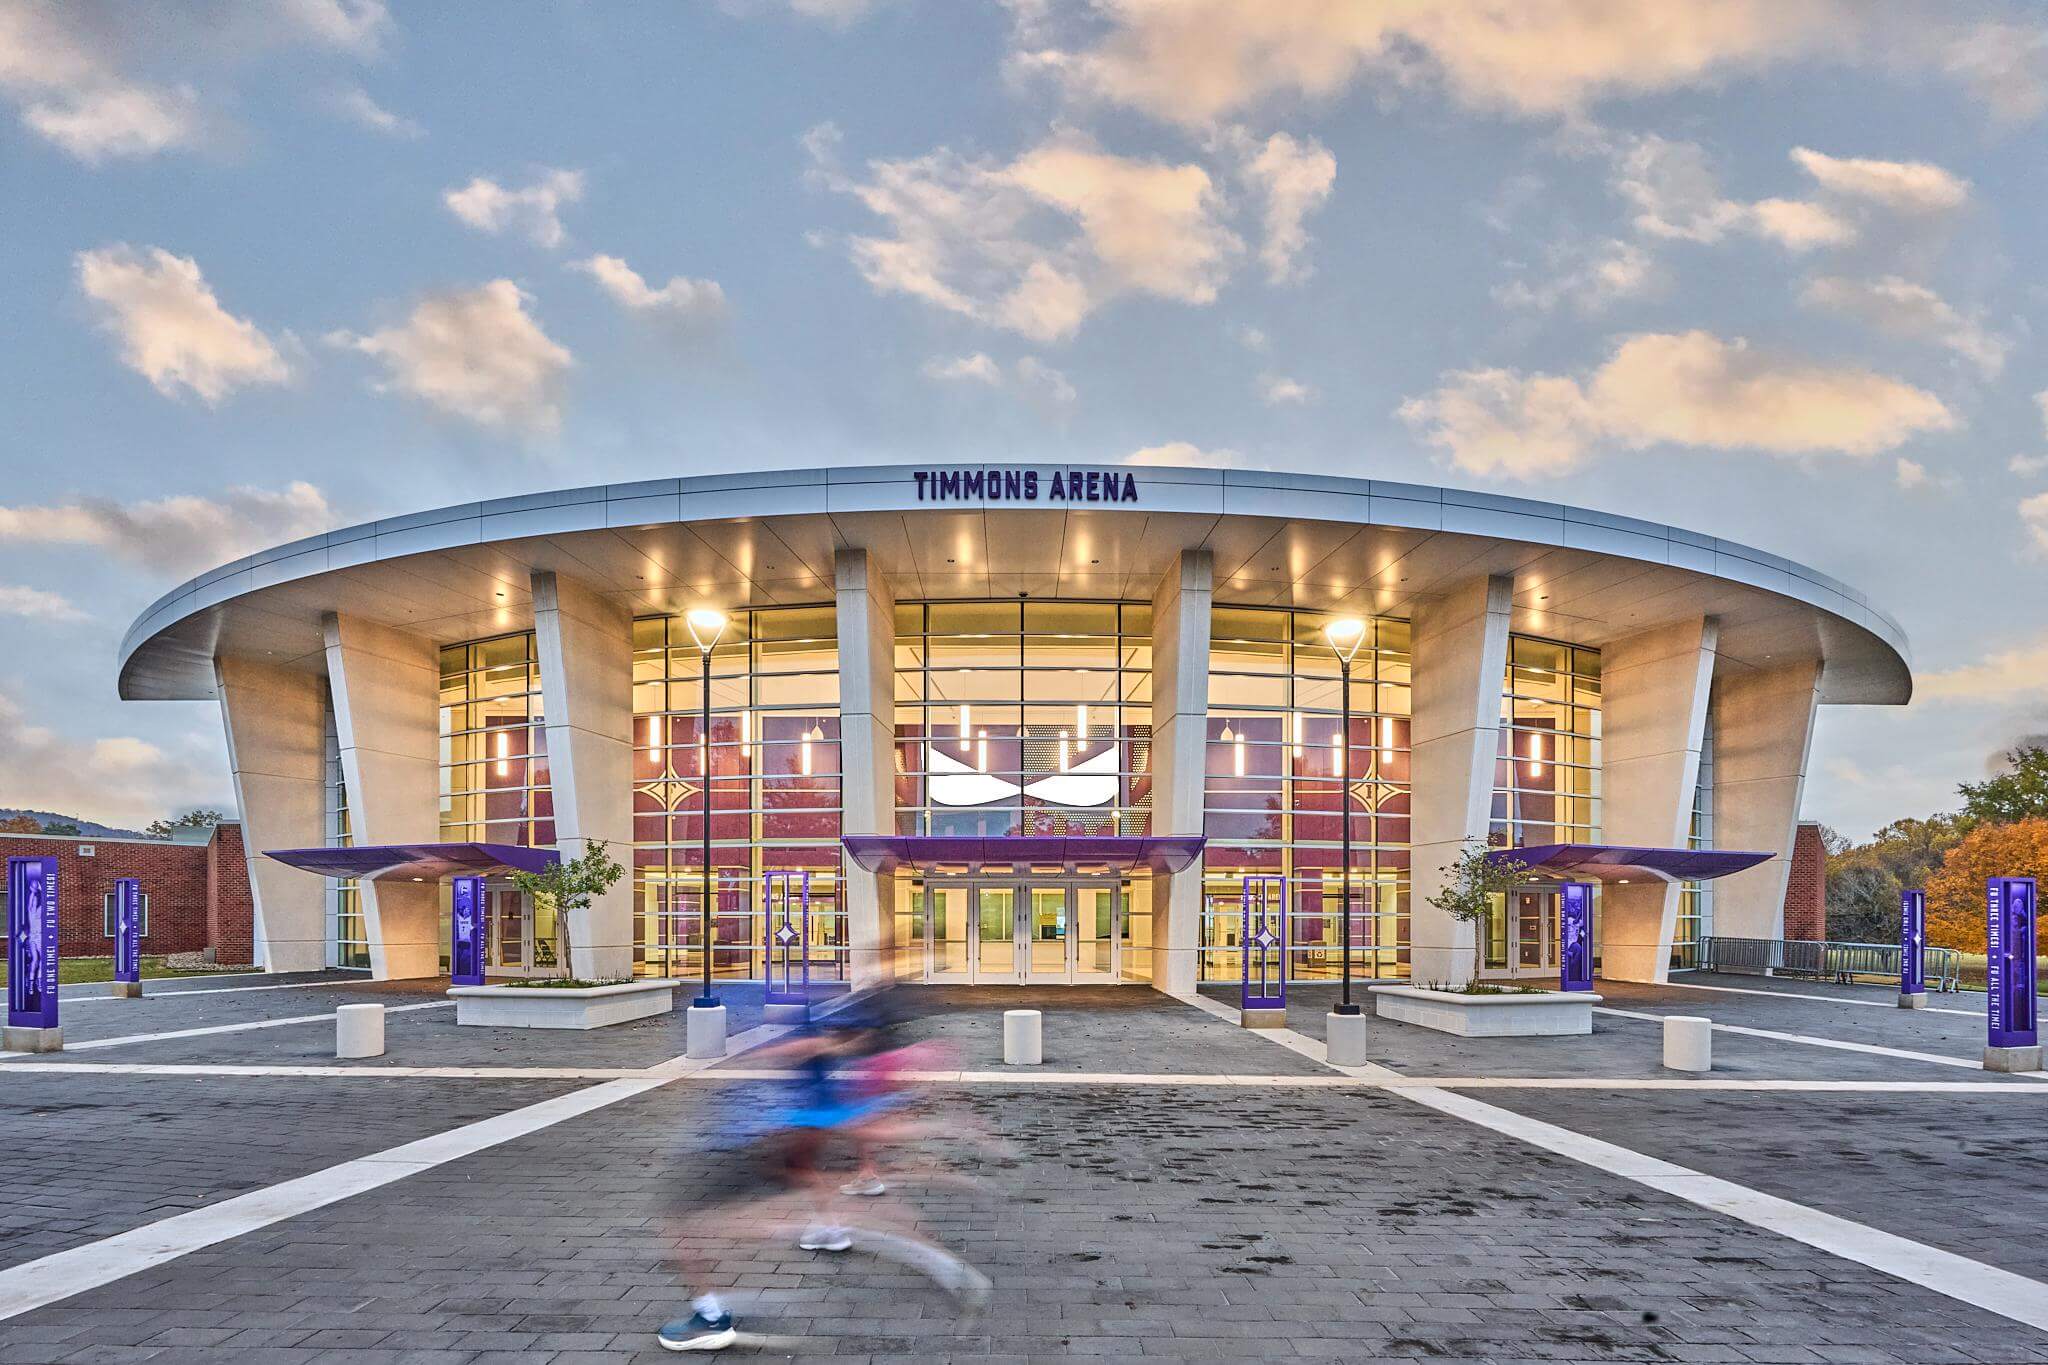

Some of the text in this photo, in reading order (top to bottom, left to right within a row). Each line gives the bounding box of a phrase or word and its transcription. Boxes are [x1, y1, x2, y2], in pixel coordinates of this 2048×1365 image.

[913, 470, 1138, 502] TIMMONS ARENA
[46, 901, 56, 916] TWO
[46, 919, 56, 928] FU
[46, 946, 56, 965] TIME!
[1990, 888, 2000, 1029] FU THREE TIMES! FU ALL THE TIME!
[46, 969, 56, 982] ONE
[46, 986, 56, 994] FU
